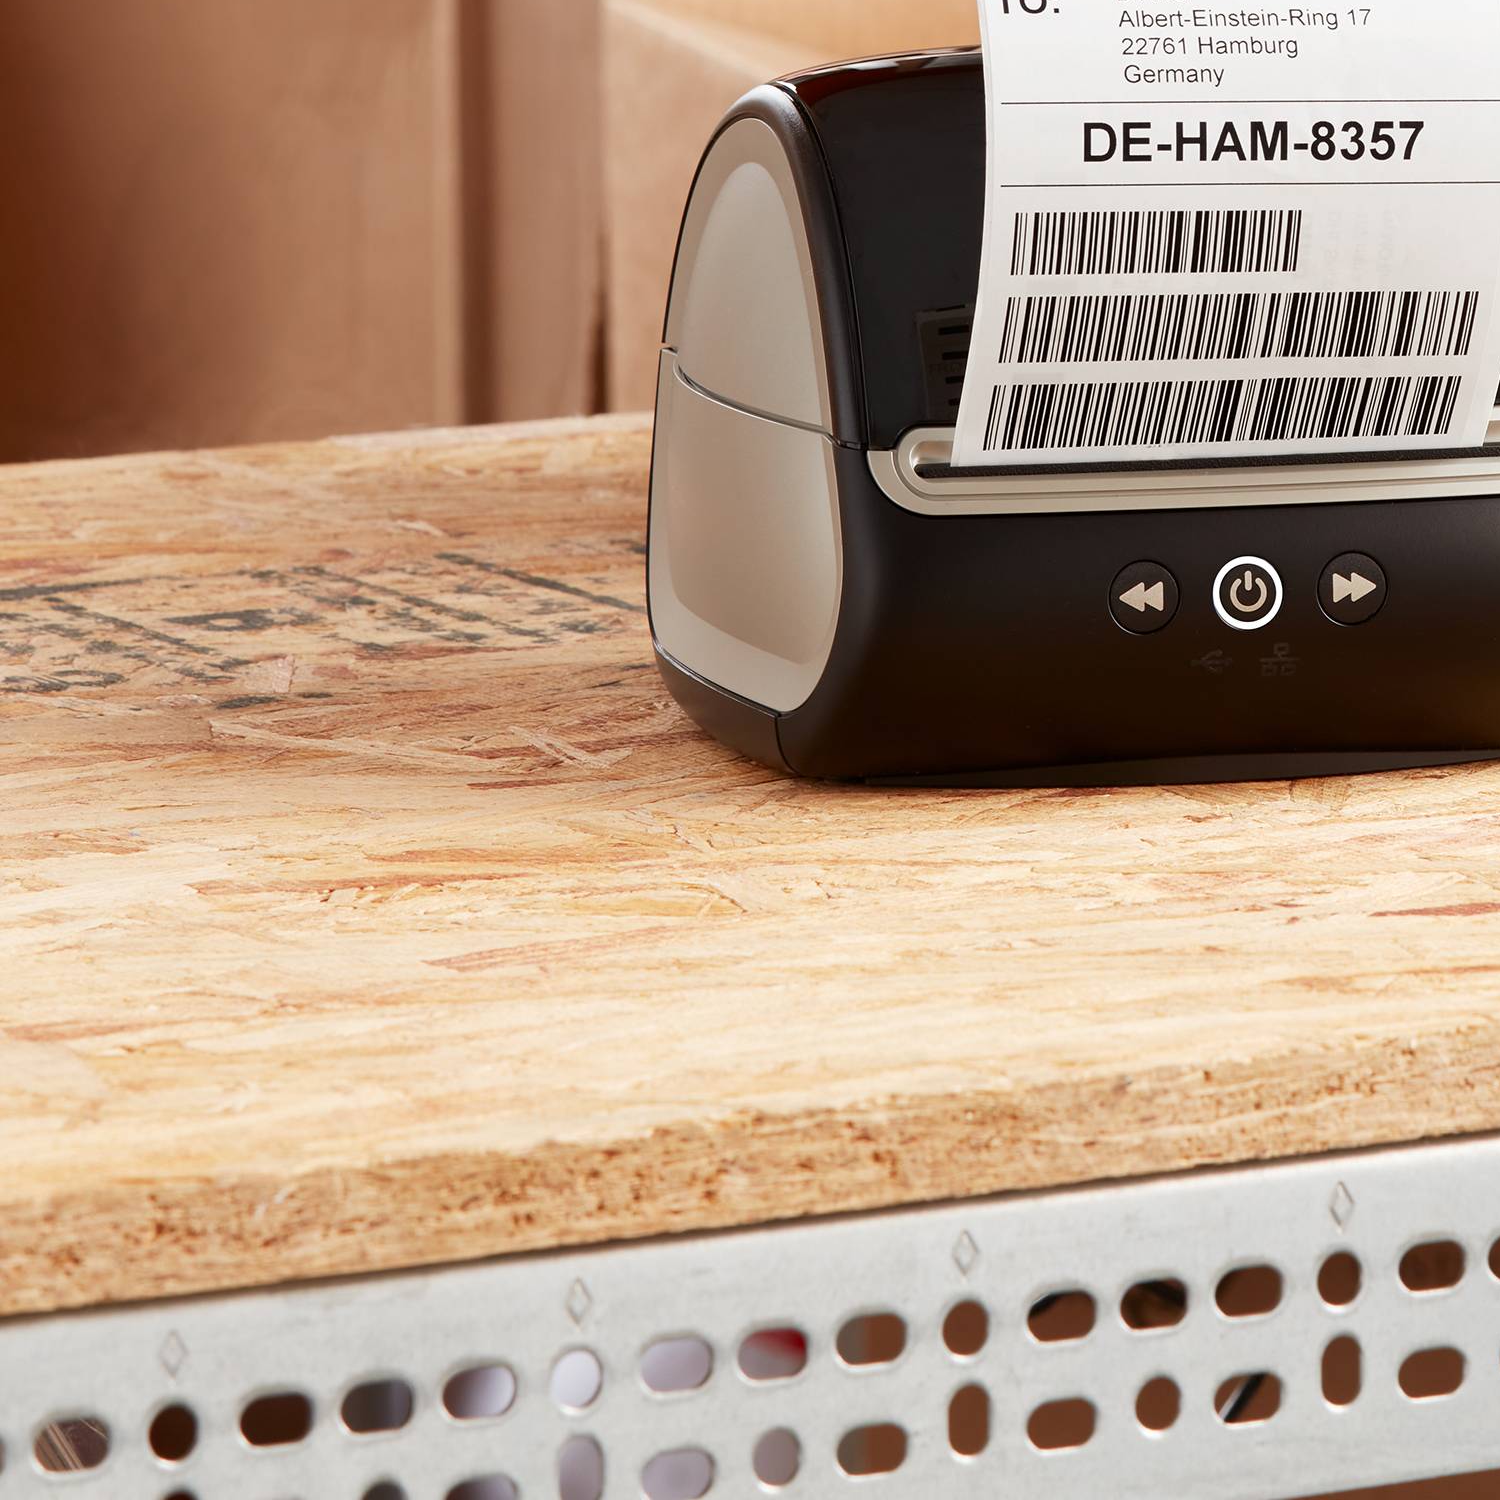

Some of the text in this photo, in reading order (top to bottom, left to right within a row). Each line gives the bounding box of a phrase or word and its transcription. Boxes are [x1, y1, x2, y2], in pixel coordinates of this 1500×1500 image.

[1118, 8, 1372, 31] Albert-Einstein-Ring 17
[1121, 35, 1299, 59] 22761 Hamburg
[1123, 64, 1225, 88] Germany
[1082, 120, 1425, 163] DE-HAM-8357
